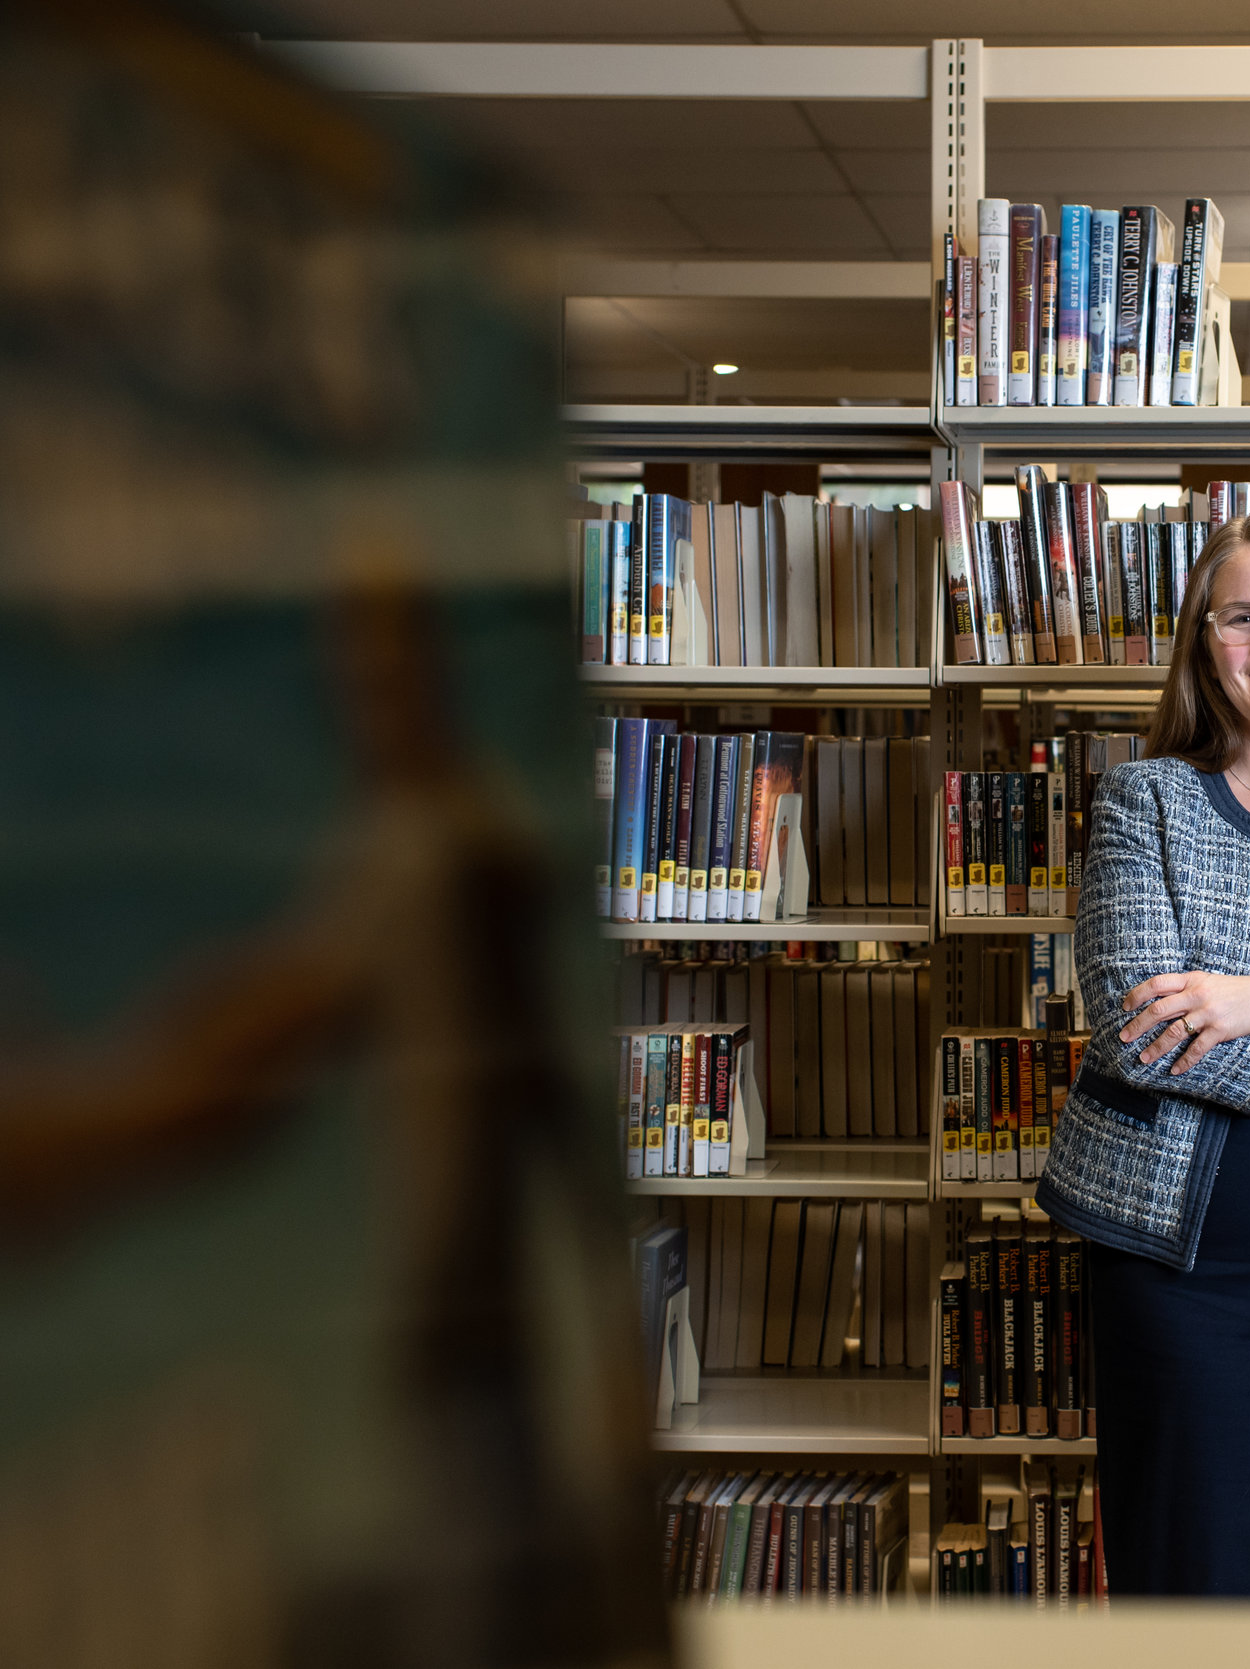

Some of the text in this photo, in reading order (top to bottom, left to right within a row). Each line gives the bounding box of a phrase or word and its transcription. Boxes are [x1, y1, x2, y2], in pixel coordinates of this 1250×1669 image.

[1091, 221, 1102, 252] TERRY
[1103, 244, 1113, 255] OF
[1104, 225, 1114, 241] CRY
[1015, 236, 1034, 312] Manifest West
[1070, 210, 1080, 308] PAULETTE JILES
[1102, 257, 1113, 275] THE
[1120, 218, 1141, 328] TERRY C. JOHNSTON
[1181, 225, 1194, 292] UPSIDE DOWN
[1190, 222, 1203, 297] TURN STARS
[1042, 260, 1057, 328] THE WILD CARD
[1090, 261, 1101, 308] JOHNSTON
[989, 259, 1000, 359] WINTER
[633, 543, 643, 592] Ambush
[1082, 576, 1096, 610] COLTER'S
[720, 742, 732, 771] Reunion
[717, 781, 729, 822] Cottonwood
[754, 772, 764, 811] TRAVIS
[665, 822, 673, 843] GOLD
[715, 823, 727, 848] Station
[699, 1077, 707, 1102] FIRST
[715, 1056, 728, 1112] ED GORMAN
[980, 1057, 988, 1117] CAMERON JUDD
[1000, 1056, 1010, 1118] CAMERON JUDD
[1020, 1060, 1033, 1126] CAMERON JUDD
[1035, 1062, 1047, 1113] CAMERON JUDD
[631, 1102, 640, 1117] FAST
[969, 1255, 979, 1289] Parker's
[979, 1251, 990, 1293] Robert B.
[999, 1252, 1009, 1290] Parker's
[1009, 1248, 1020, 1294] Robert B.
[1027, 1254, 1038, 1292] Parker's
[1039, 1250, 1050, 1296] Robert B.
[1059, 1256, 1069, 1290] Parker's
[1069, 1253, 1080, 1294] Robert B.
[943, 1314, 951, 1365] BULL RIVER
[1003, 1298, 1015, 1370] BLACKJACK
[1033, 1300, 1044, 1372] BLACKJACK
[1035, 1502, 1046, 1547] LOUIS
[1059, 1505, 1070, 1550] LOUIS
[748, 1519, 765, 1589] THE HANGING
[788, 1514, 799, 1604] GUNS OF JEOPARDY
[829, 1536, 838, 1579] MARBLE
